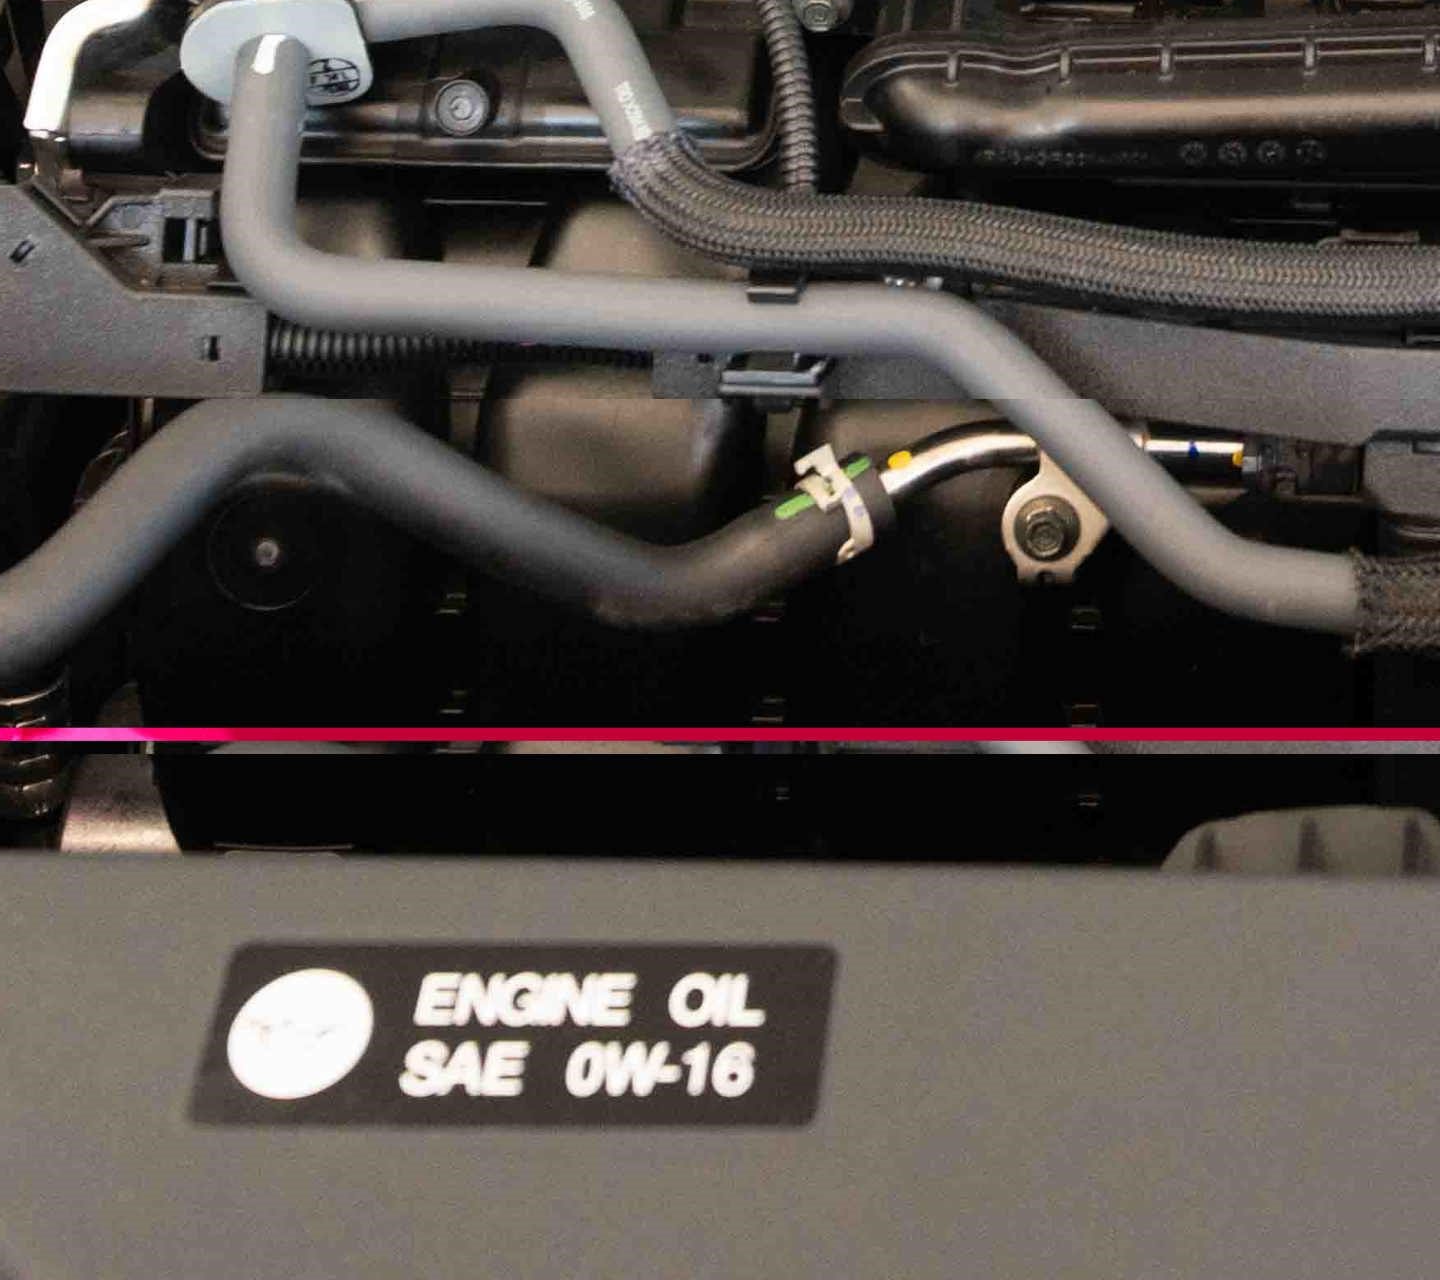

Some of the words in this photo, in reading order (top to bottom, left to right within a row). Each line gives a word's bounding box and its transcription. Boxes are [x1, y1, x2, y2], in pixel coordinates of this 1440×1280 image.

[412, 970, 638, 1030] ENGINE
[667, 970, 766, 1029] OIL
[398, 1039, 530, 1099] SAE
[565, 1039, 757, 1099] 0W-16
